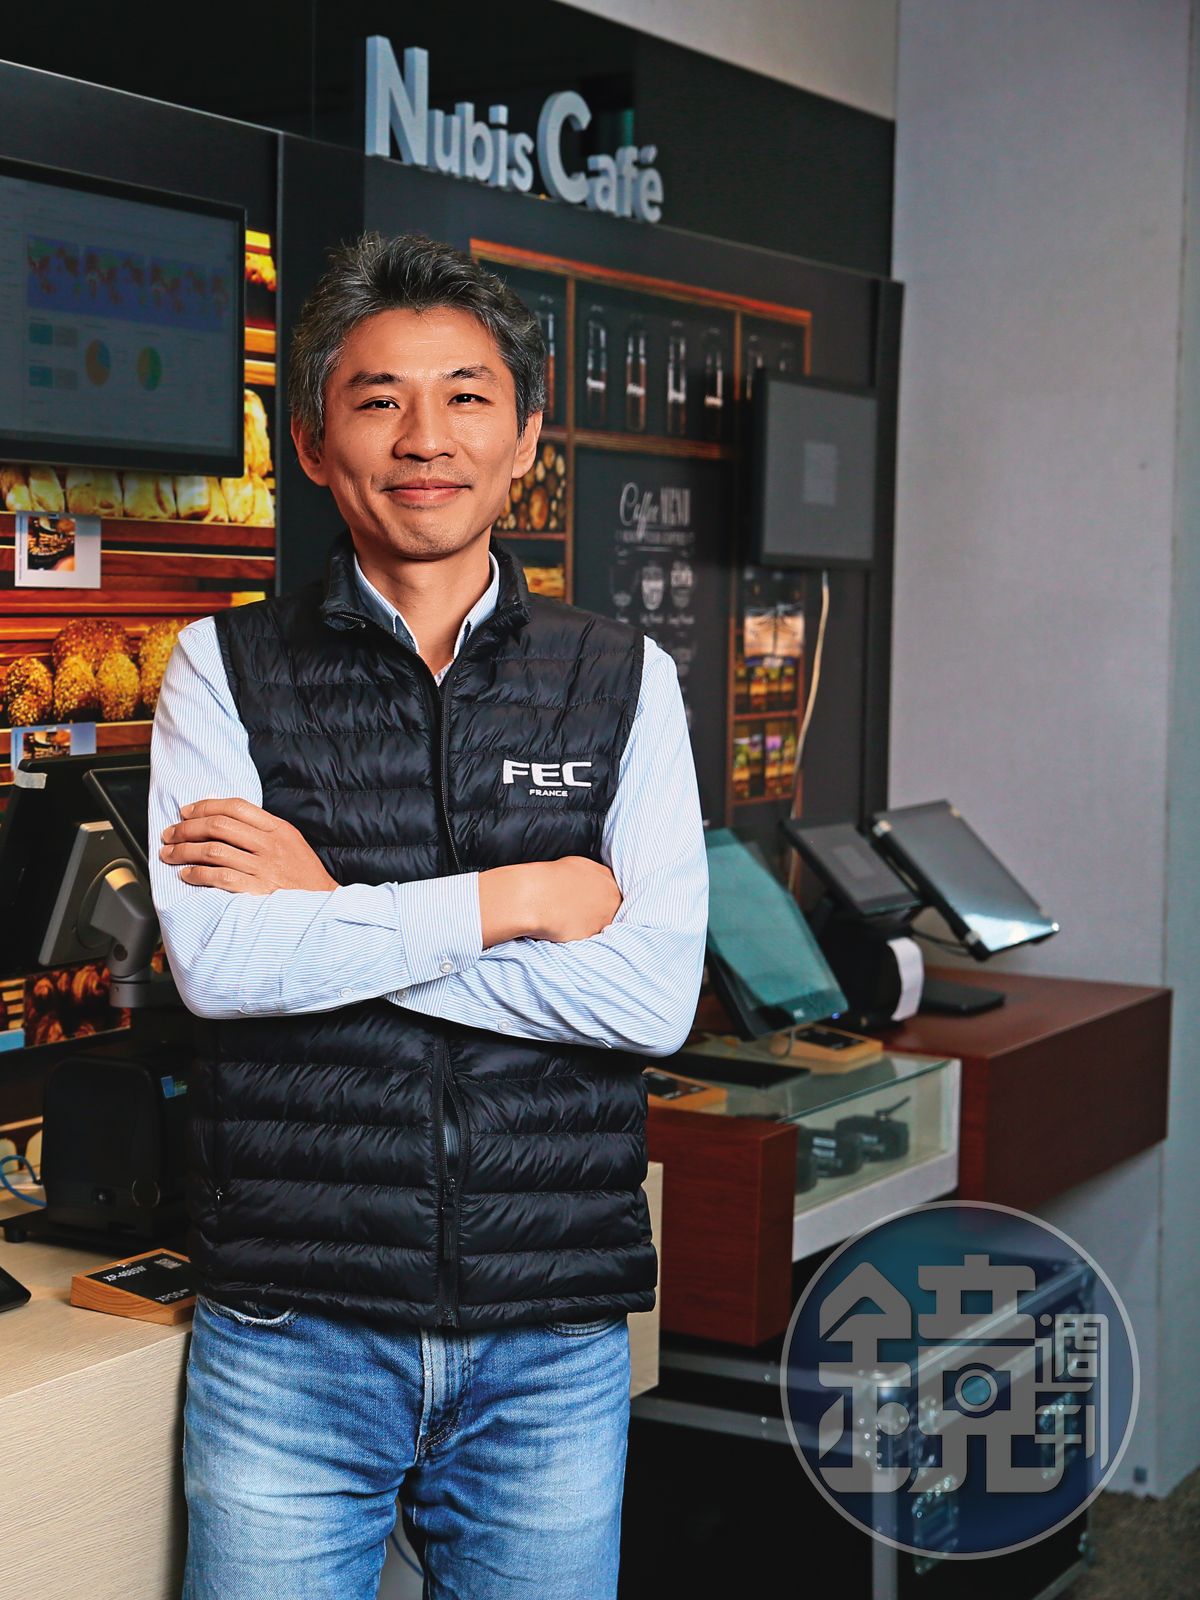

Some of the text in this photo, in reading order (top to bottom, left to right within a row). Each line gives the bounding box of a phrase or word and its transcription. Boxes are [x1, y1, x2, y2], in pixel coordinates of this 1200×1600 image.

[365, 34, 664, 223] Nubis Café
[502, 759, 592, 787] FEC
[529, 789, 568, 797] FRANCE
